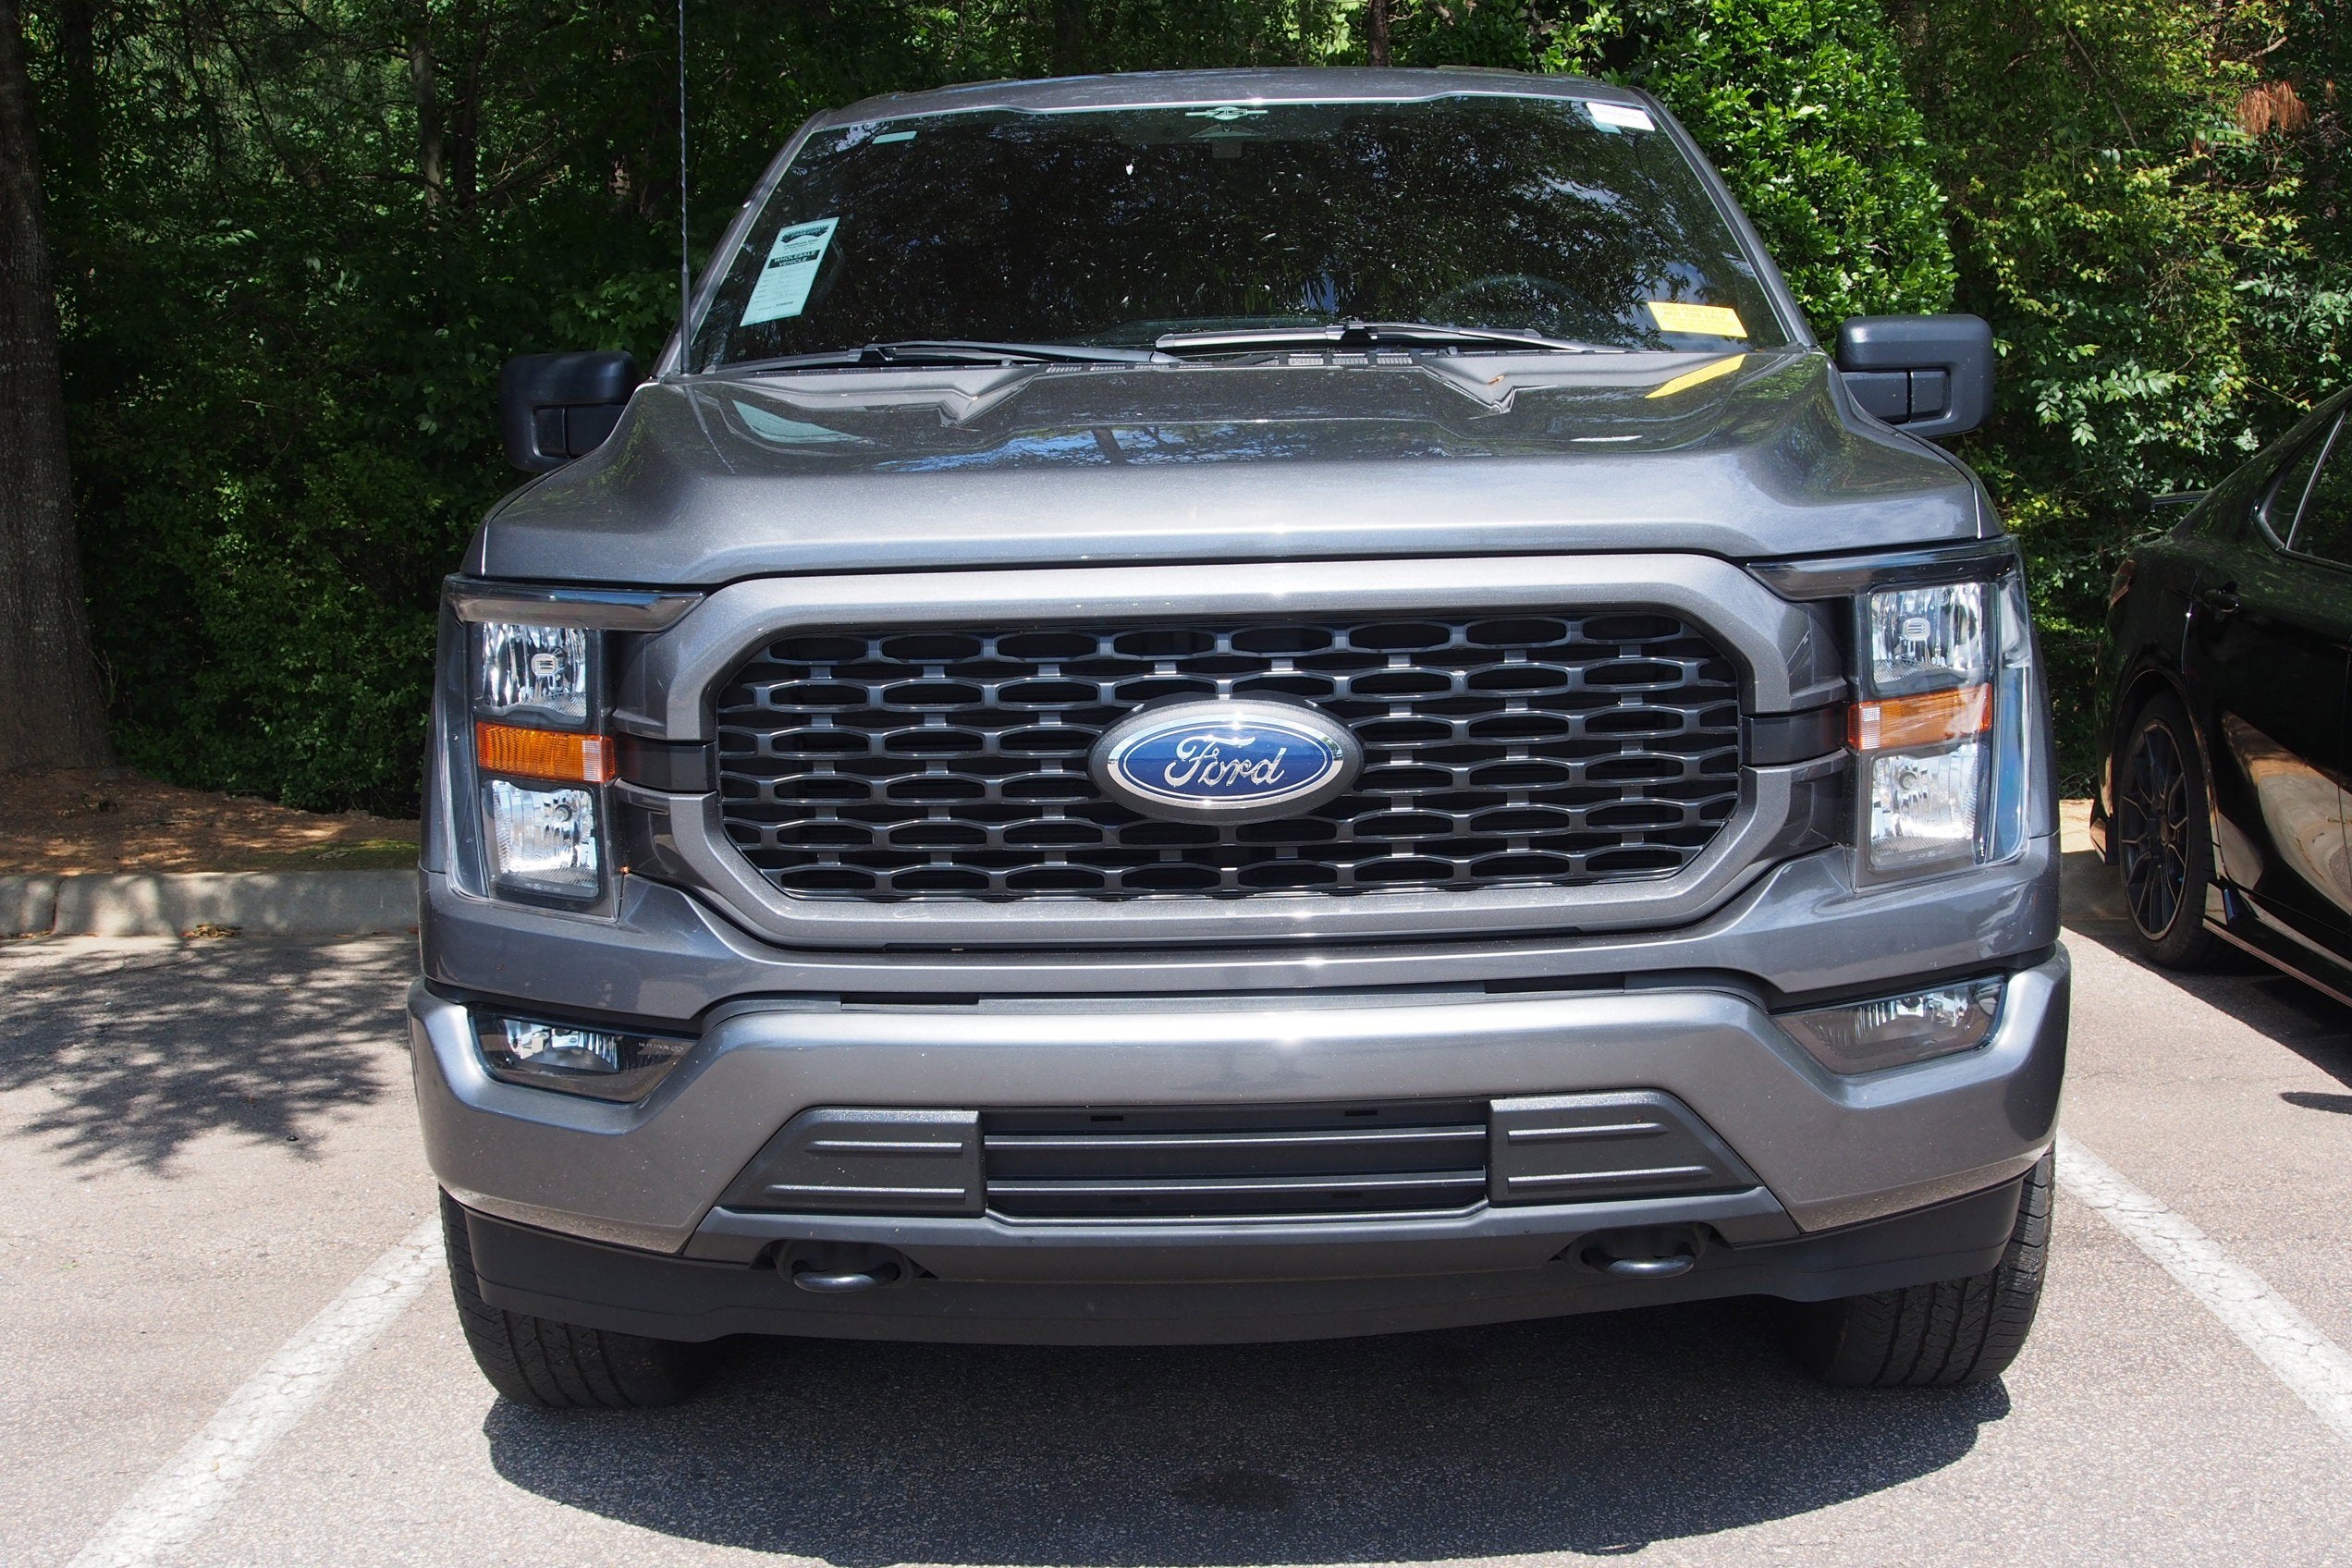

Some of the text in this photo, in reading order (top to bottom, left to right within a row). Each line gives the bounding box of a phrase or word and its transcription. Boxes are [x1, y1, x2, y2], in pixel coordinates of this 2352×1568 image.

[774, 251, 815, 263] WHOLESALE
[778, 256, 808, 266] VEHICLE
[1163, 735, 1287, 788] Ford
